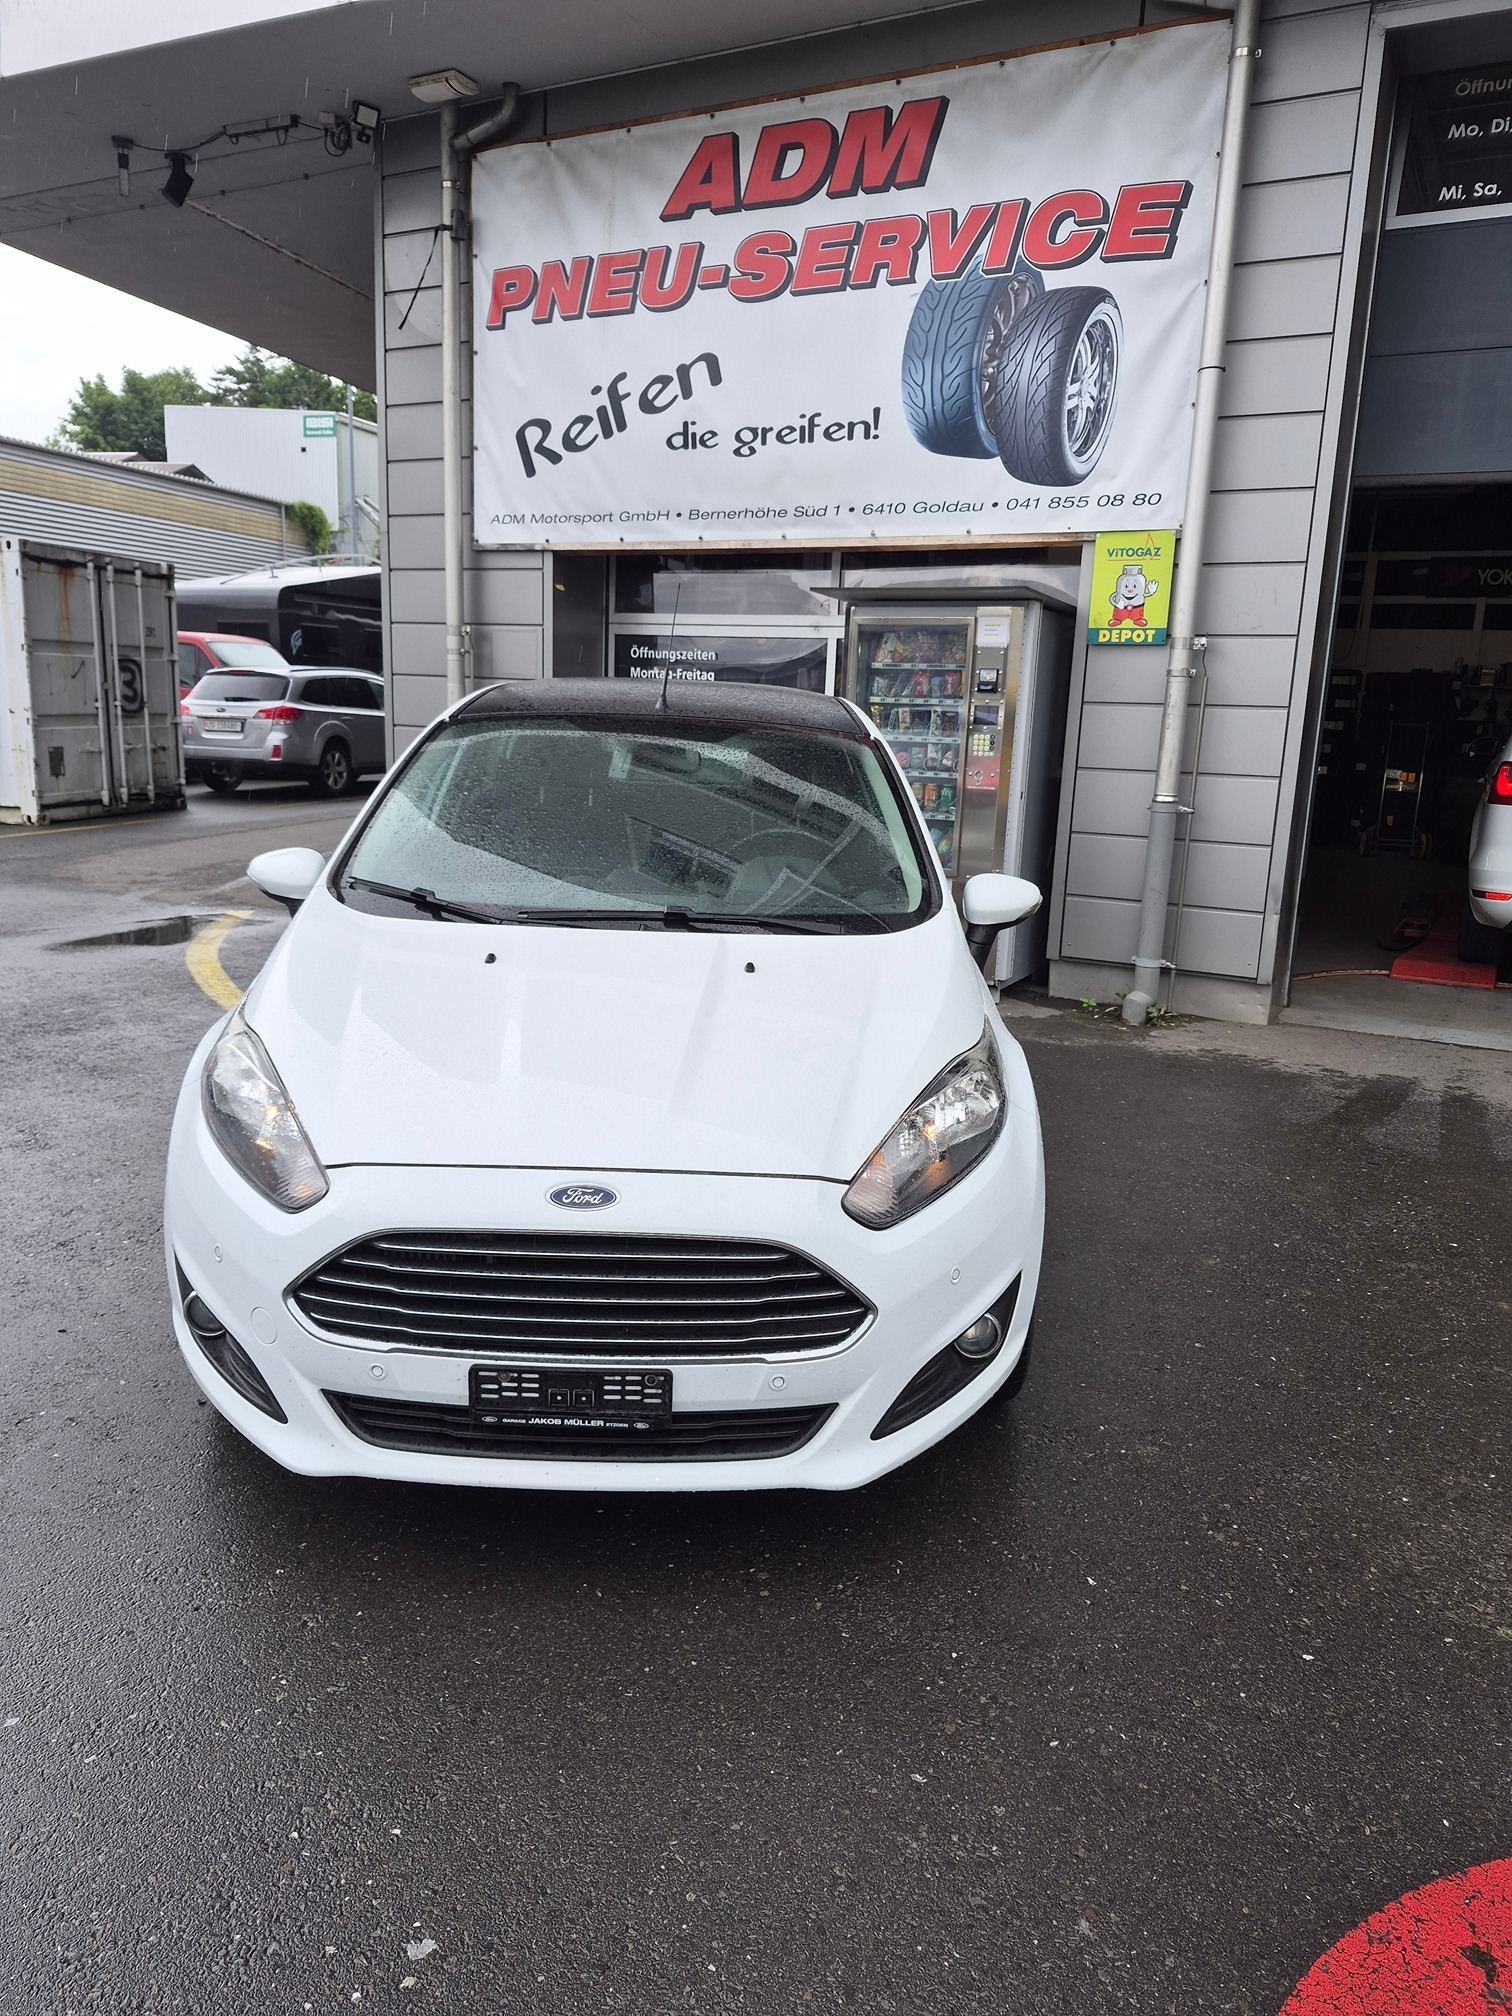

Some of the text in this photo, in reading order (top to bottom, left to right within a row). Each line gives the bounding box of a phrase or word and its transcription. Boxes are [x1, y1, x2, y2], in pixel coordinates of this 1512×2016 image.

[1447, 123, 1484, 139] Mo,
[660, 95, 950, 222] ADM
[1438, 182, 1503, 201] Mi, Sa,
[485, 179, 1194, 330] PNEU-SERVICE
[514, 351, 723, 478] Reifen
[665, 407, 882, 458] die greifen!
[490, 492, 1163, 526] ADM Motorsport GmbH Bernerhöhe Süd 1 6410 Goldau 041 855 08 80
[1098, 629, 1155, 643] DEPOT
[630, 645, 716, 661] Öffnungszeiten
[562, 1188, 603, 1204] Ford
[564, 1418, 604, 1427] MÜLLER
